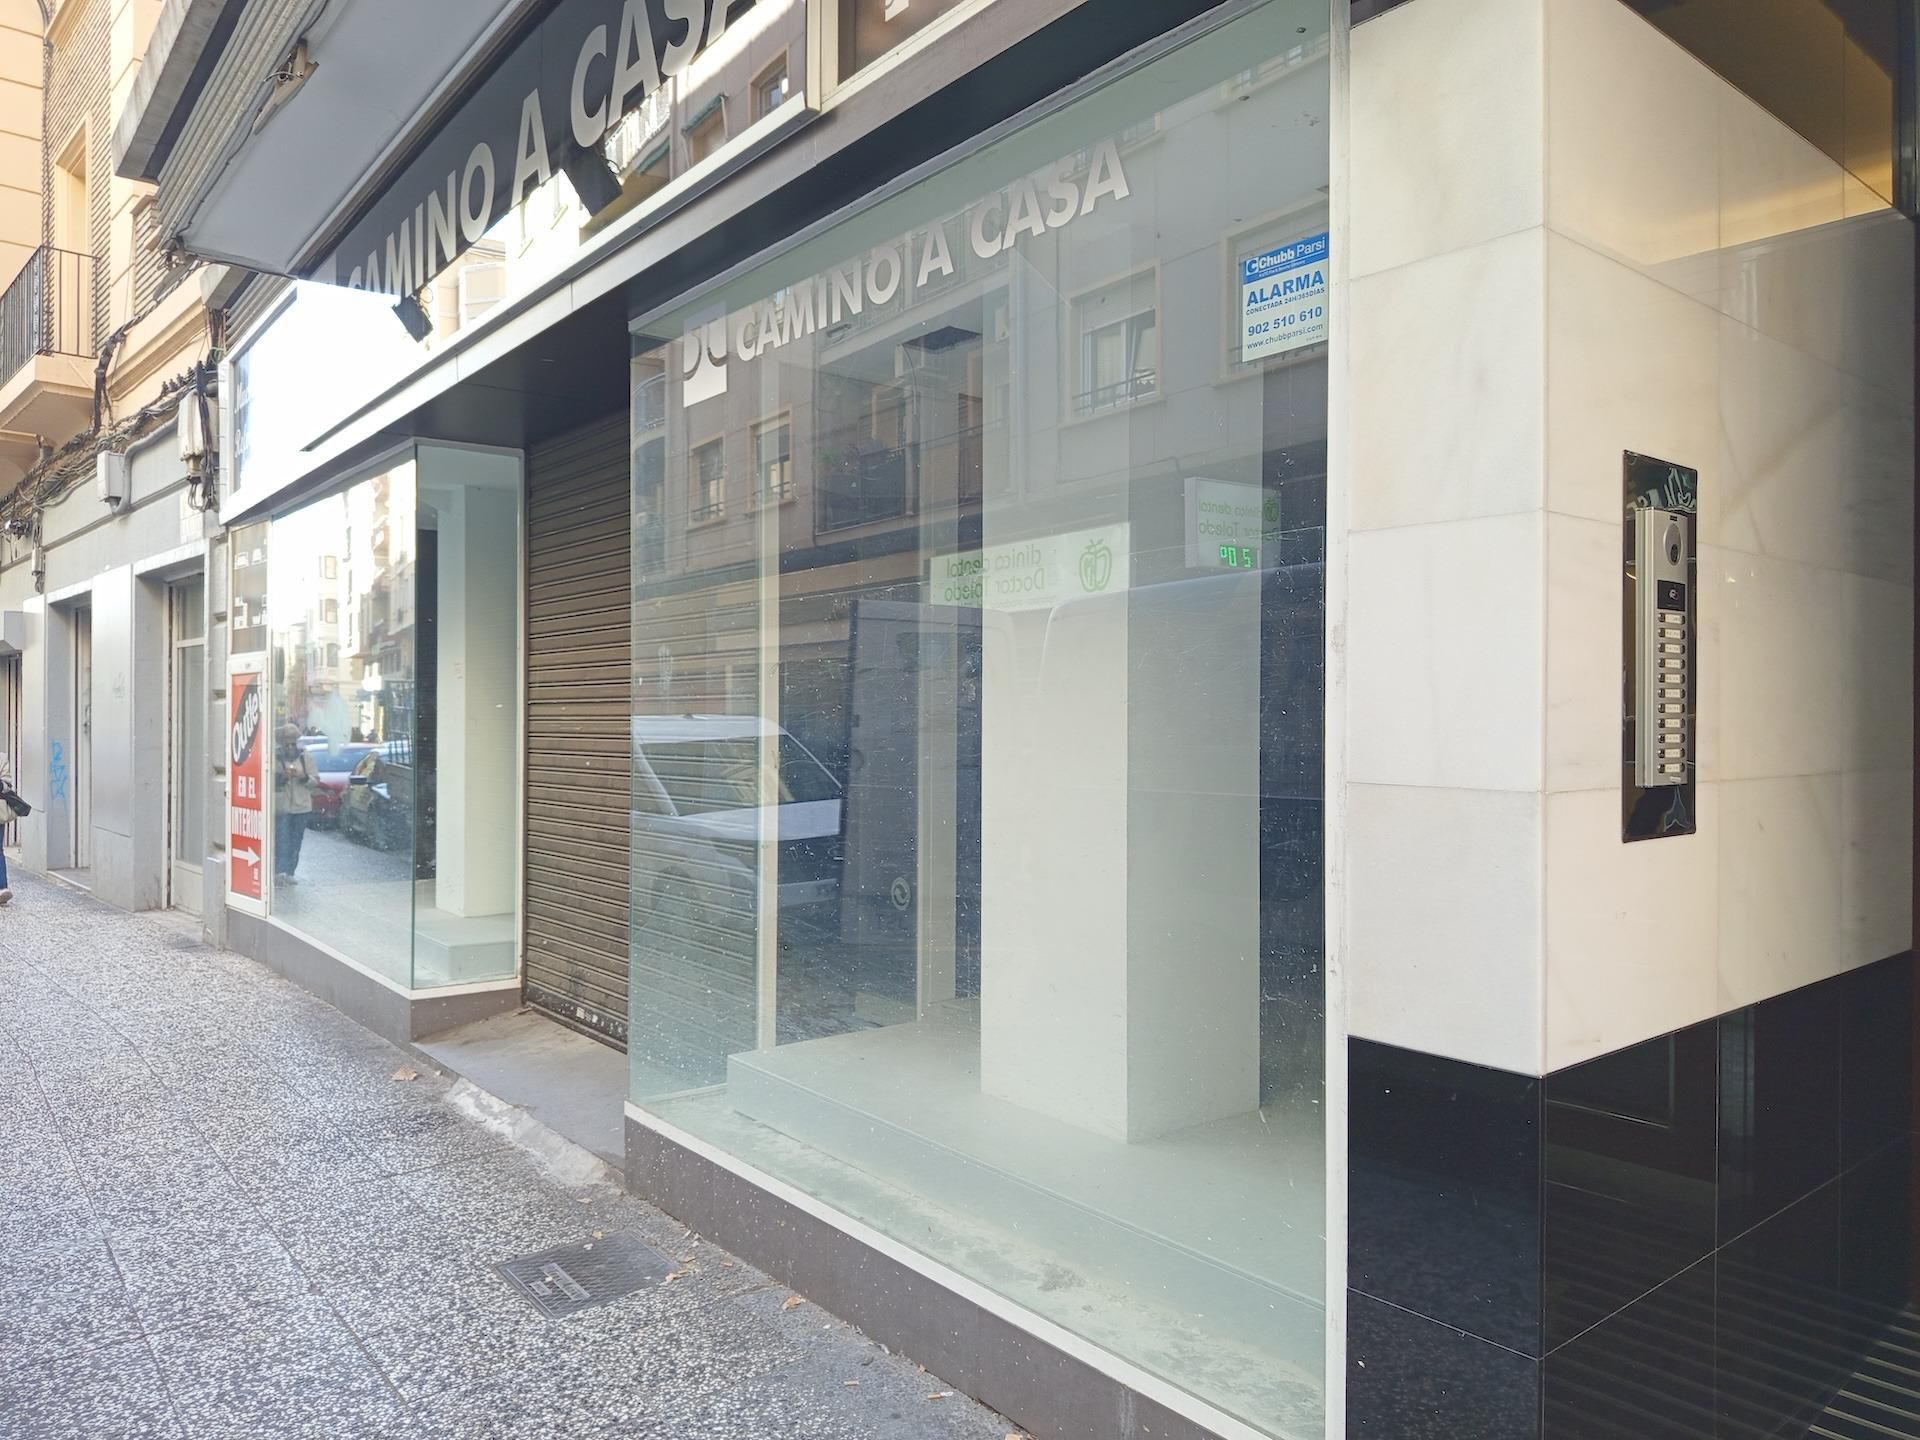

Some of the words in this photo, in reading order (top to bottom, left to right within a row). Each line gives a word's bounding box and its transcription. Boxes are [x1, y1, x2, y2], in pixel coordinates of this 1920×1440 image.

[511, 88, 551, 208] A
[736, 243, 901, 362] CAMINO
[916, 222, 954, 287] A
[970, 138, 1131, 259] CASA
[1259, 249, 1294, 269] Chubb
[1297, 237, 1325, 257] Parsi
[1247, 270, 1324, 307] ALARMA
[1246, 300, 1282, 316] CONECTADA
[1248, 321, 1269, 337] 902
[1273, 314, 1296, 330] 510
[1300, 306, 1322, 322] 610
[1247, 323, 1323, 349] www.chubbparsi.com
